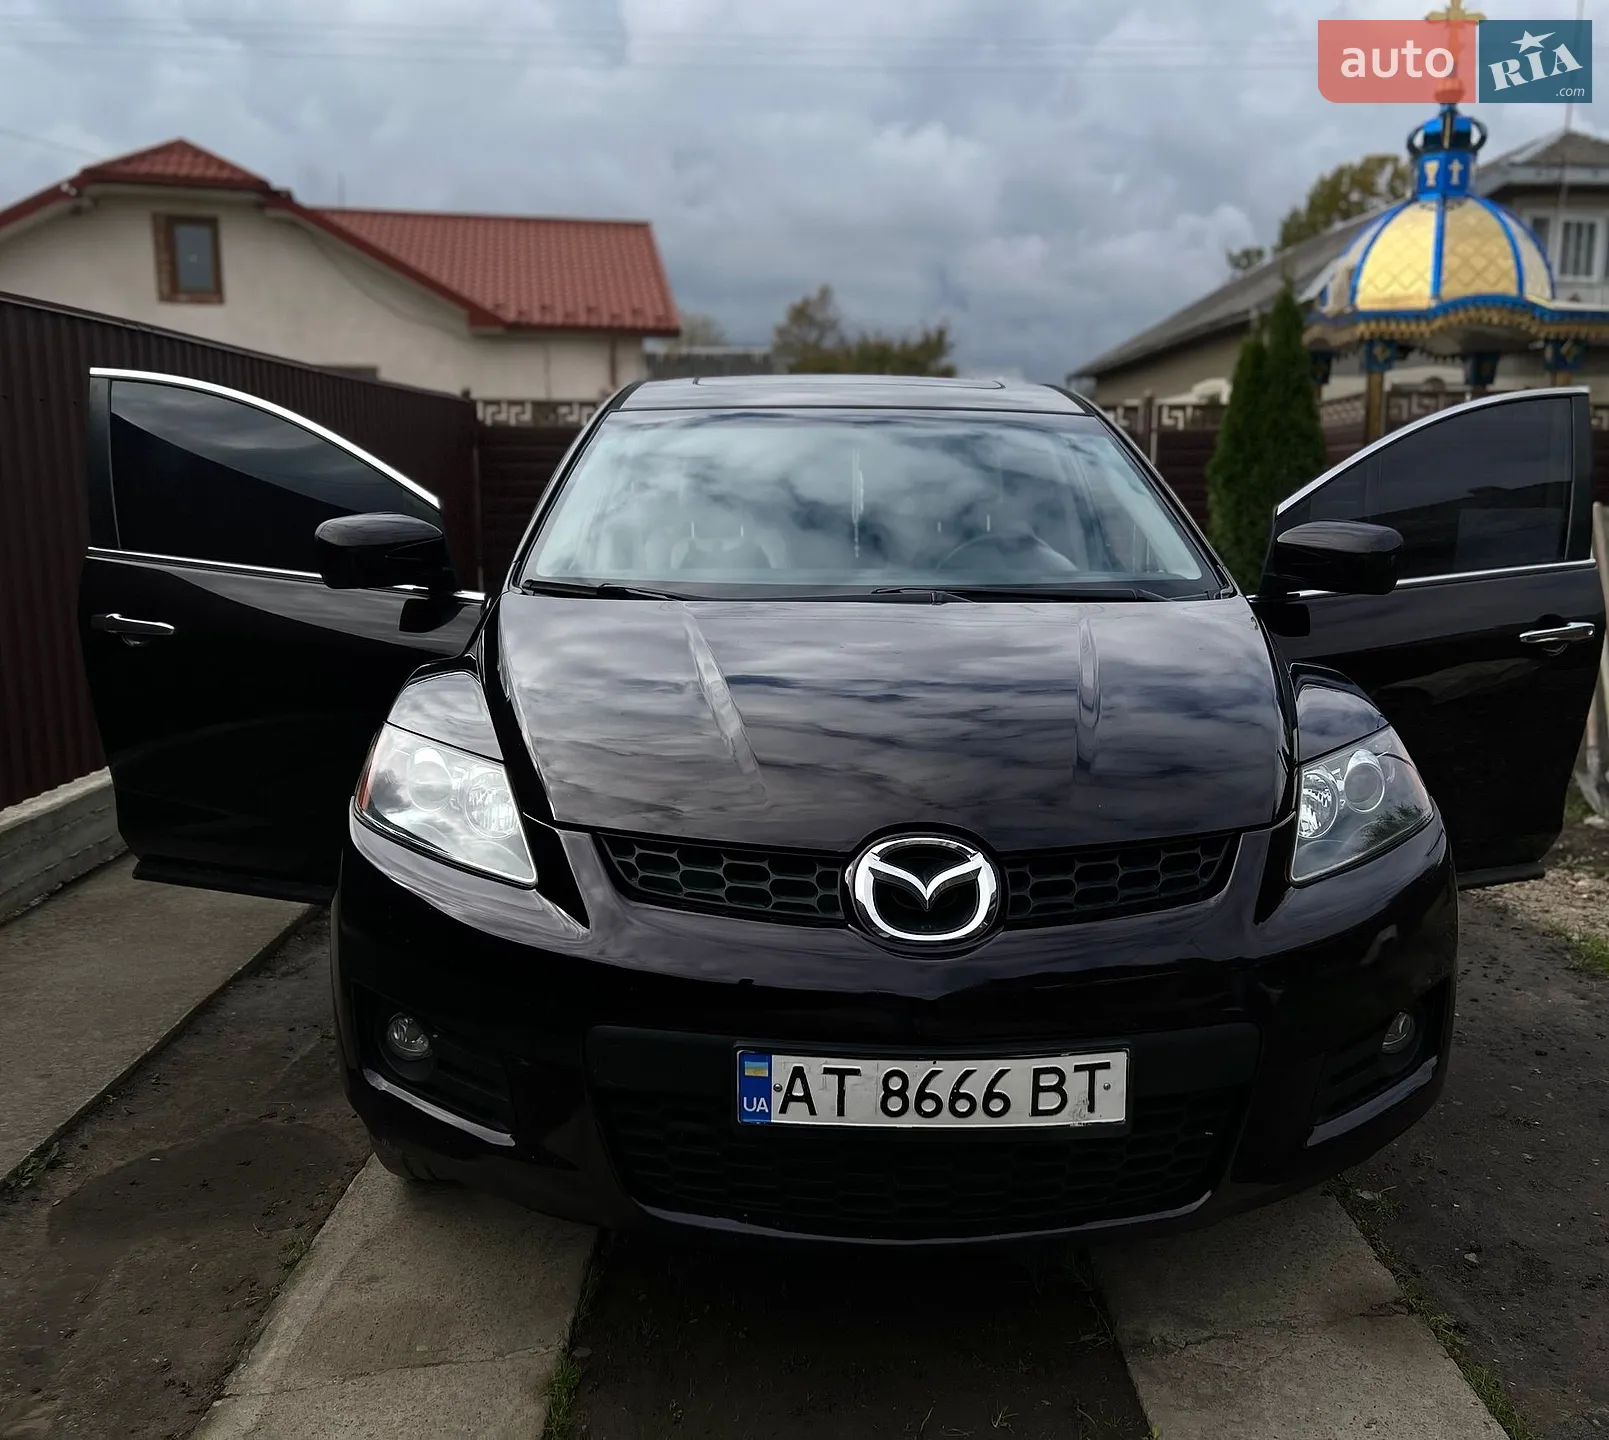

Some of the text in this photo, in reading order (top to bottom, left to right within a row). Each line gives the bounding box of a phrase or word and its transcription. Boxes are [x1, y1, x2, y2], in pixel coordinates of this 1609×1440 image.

[743, 1097, 769, 1113] UA
[778, 1061, 1111, 1118] AT 8666 BT
